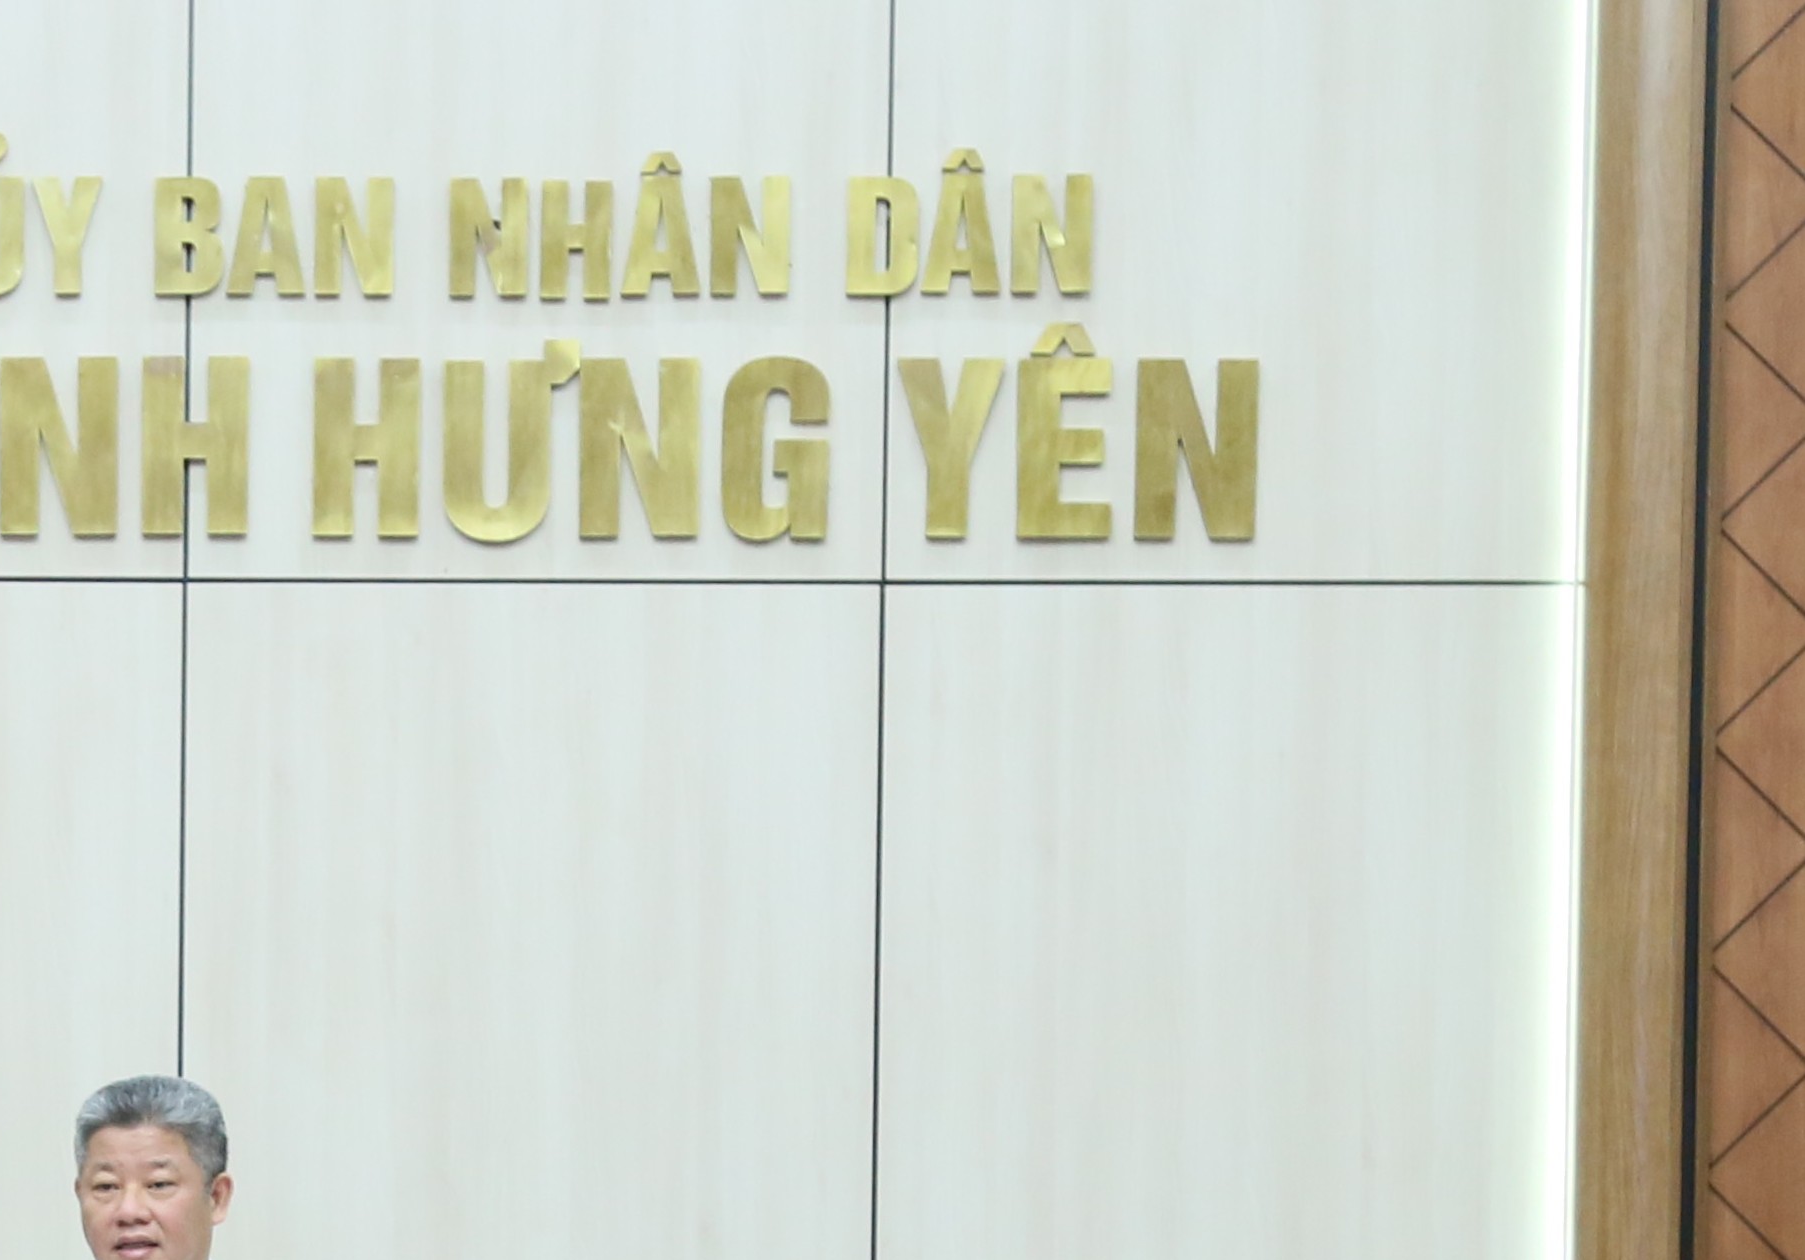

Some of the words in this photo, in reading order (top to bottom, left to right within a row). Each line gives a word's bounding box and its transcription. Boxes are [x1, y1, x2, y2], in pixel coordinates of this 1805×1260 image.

[154, 176, 394, 299] BAN
[448, 151, 792, 302] NHÂN
[845, 148, 1094, 298] DÂN
[311, 338, 831, 544] HƯNG
[897, 322, 1261, 542] YÊN
